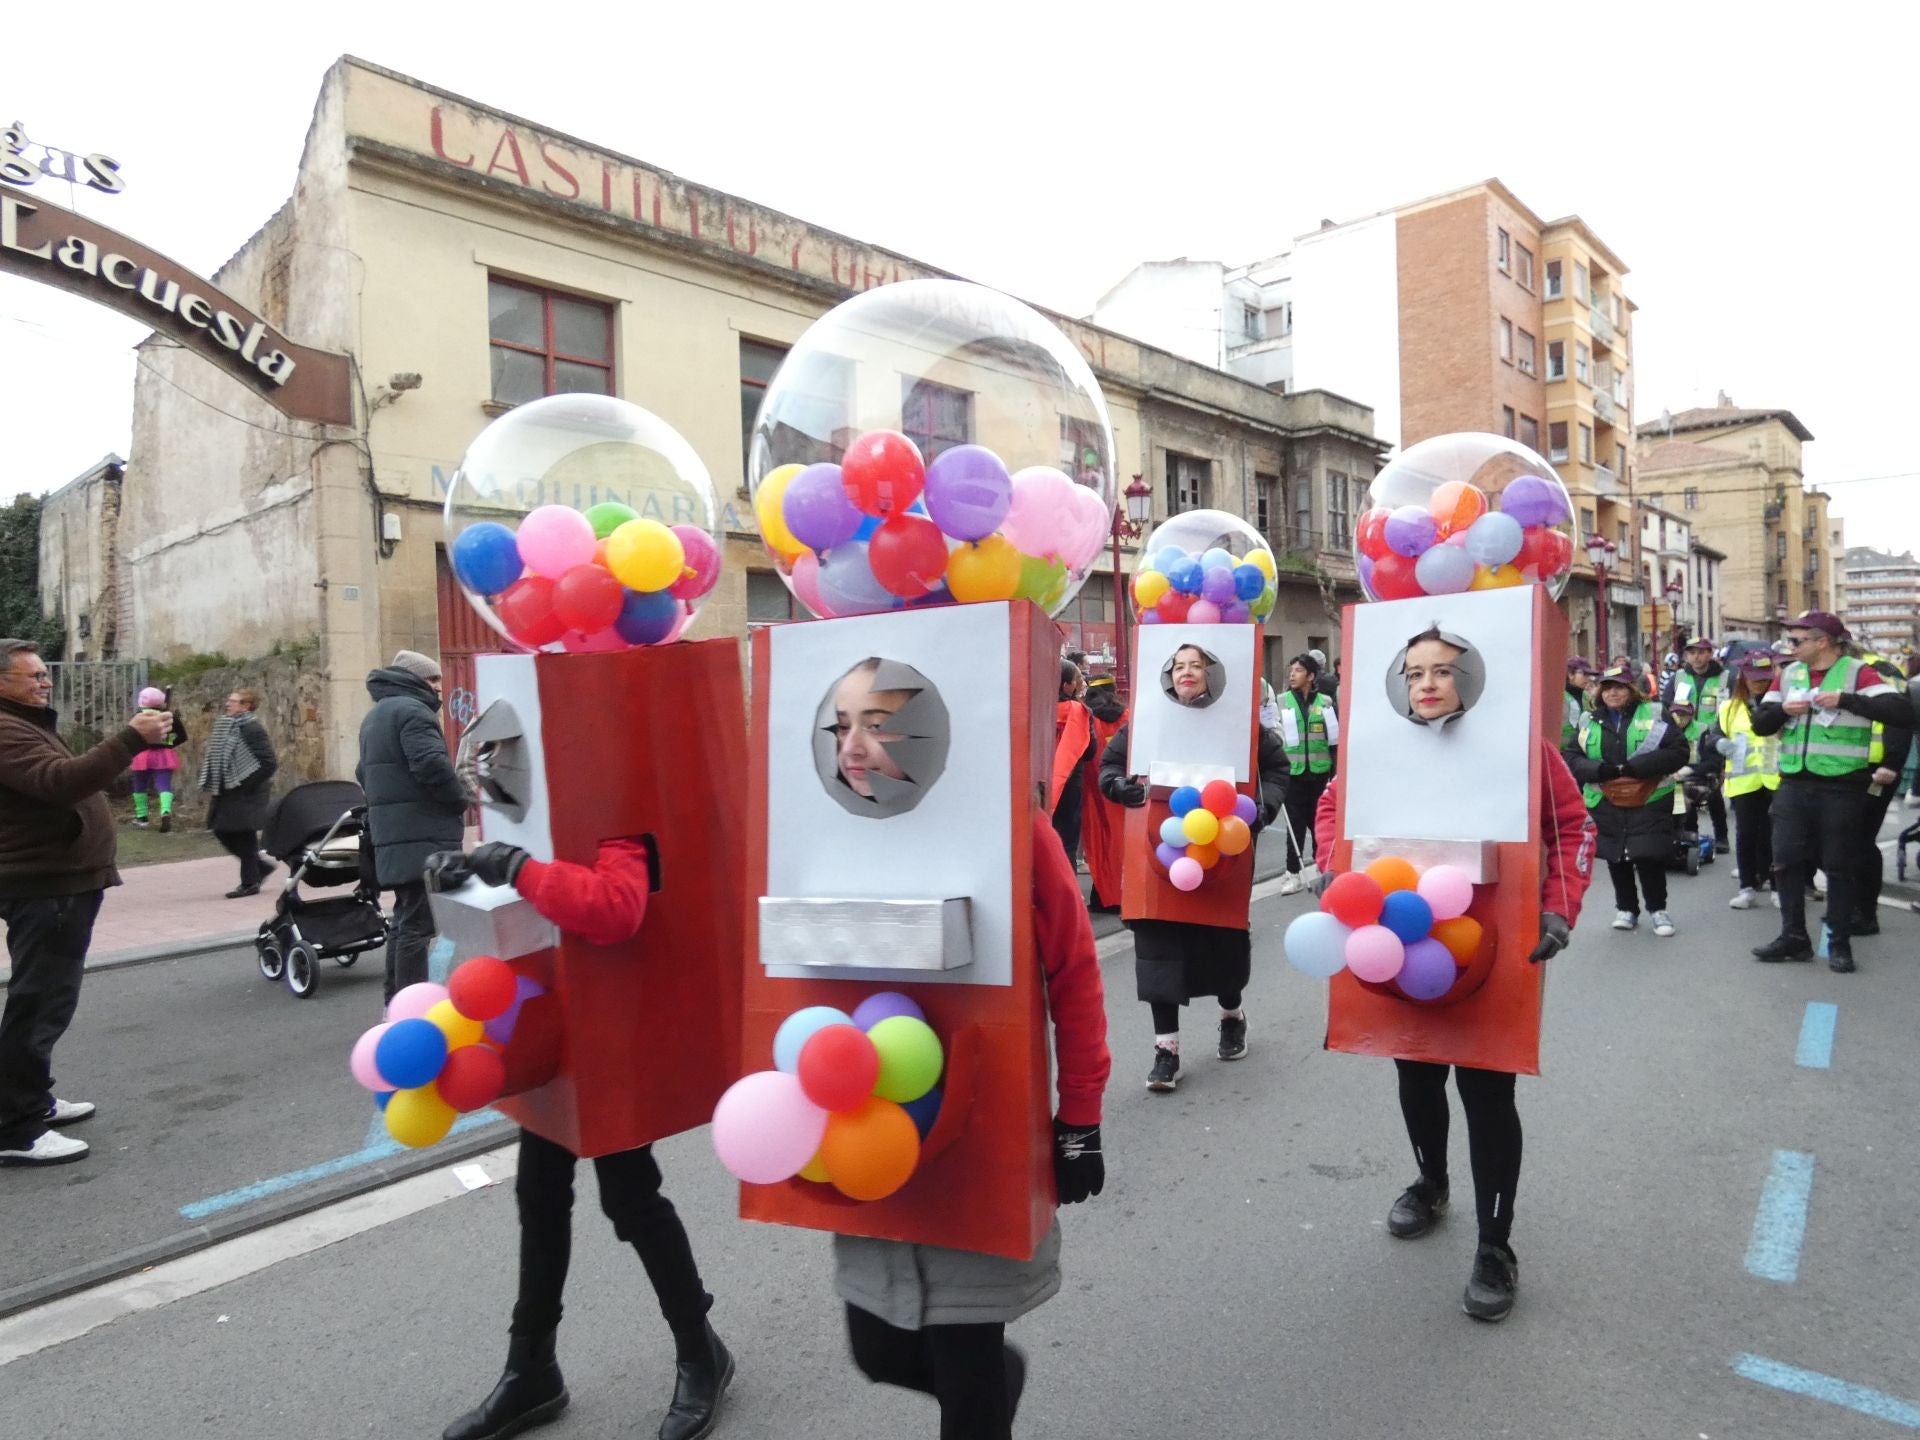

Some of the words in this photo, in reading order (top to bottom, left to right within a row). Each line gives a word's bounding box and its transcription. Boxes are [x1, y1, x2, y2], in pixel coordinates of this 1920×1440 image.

[0, 120, 127, 194] gas
[429, 102, 758, 257] CASTILLO
[1, 196, 296, 386] Lacuesta
